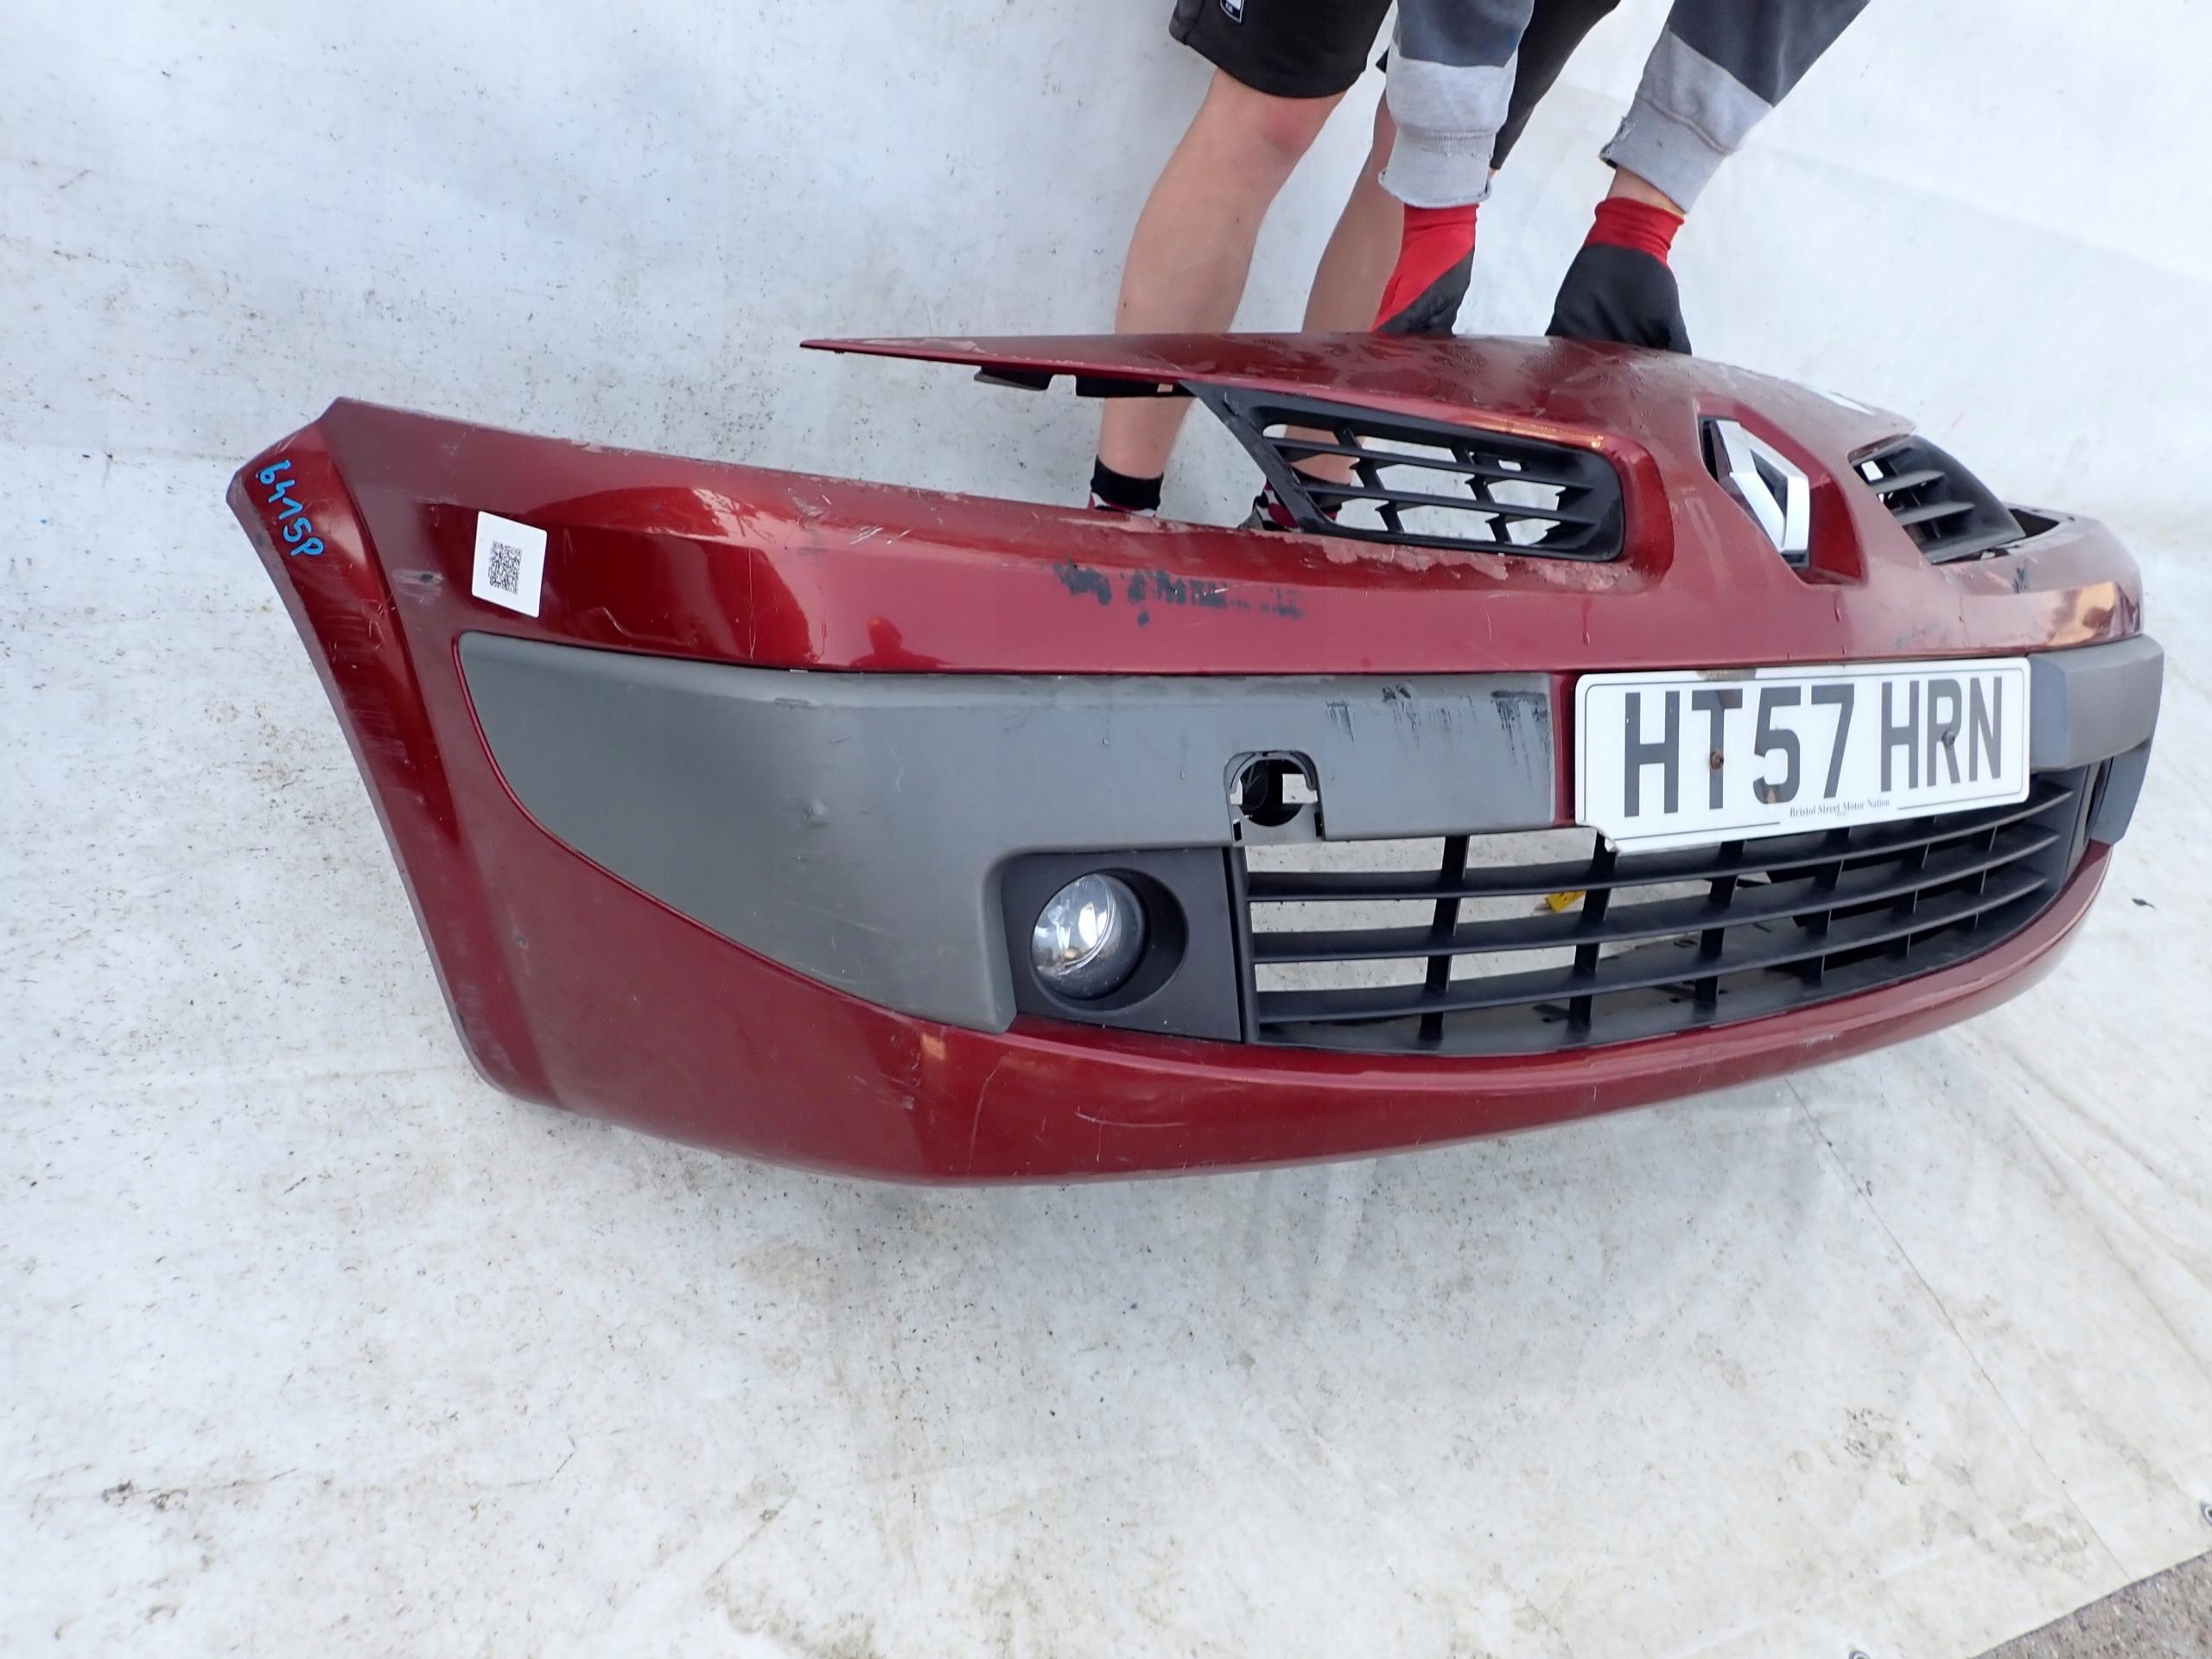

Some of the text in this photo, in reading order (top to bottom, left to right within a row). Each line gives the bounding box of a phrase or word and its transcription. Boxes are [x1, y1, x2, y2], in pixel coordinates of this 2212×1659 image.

[1624, 676, 2003, 817] HT57 HRN
[1789, 804, 1816, 817] Bristol
[1818, 802, 1841, 814] Street
[1842, 799, 1865, 812] Motor
[1867, 797, 1891, 809] Nation
